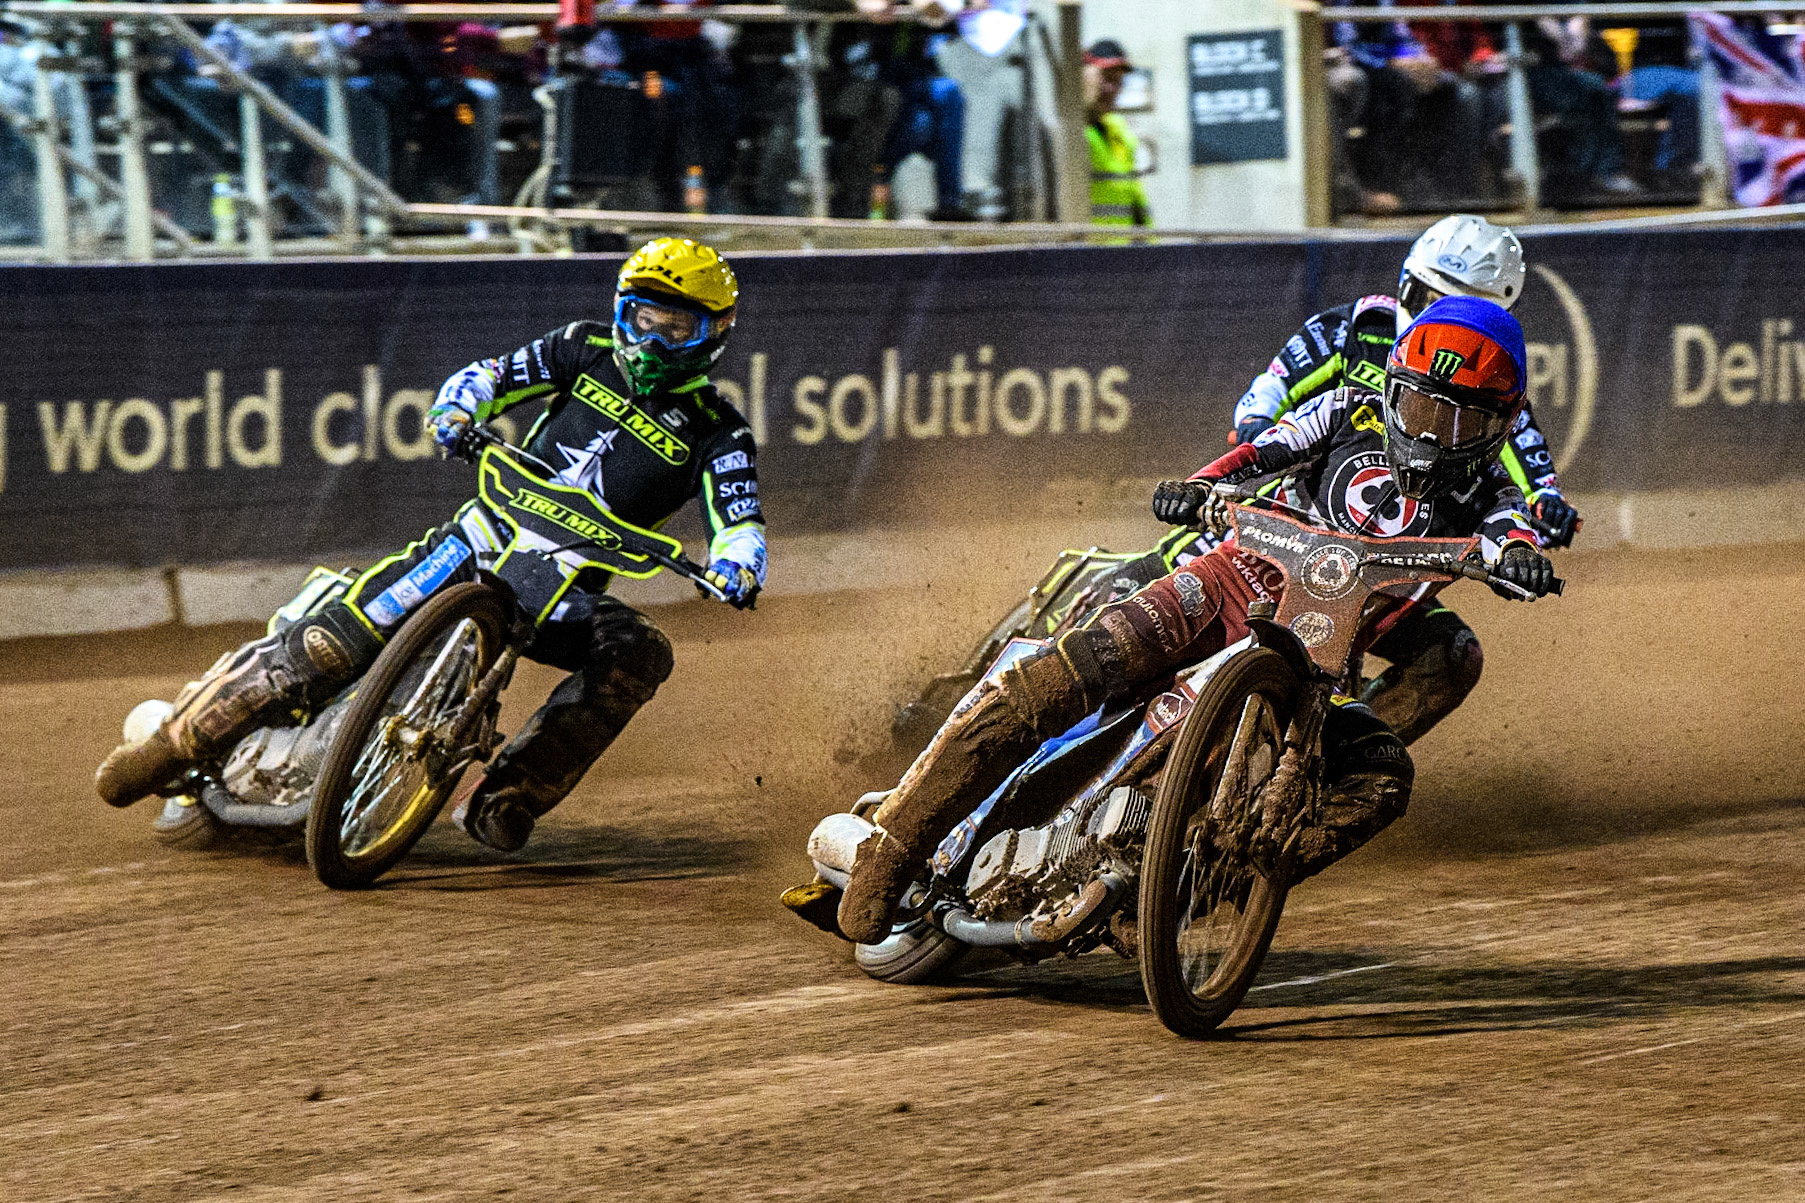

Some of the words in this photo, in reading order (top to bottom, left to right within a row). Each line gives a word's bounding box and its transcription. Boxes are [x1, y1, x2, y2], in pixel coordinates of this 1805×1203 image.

[793, 344, 1133, 446] solutions
[1670, 317, 1805, 409] Deli
[38, 368, 283, 475] world
[626, 413, 683, 458] MIX
